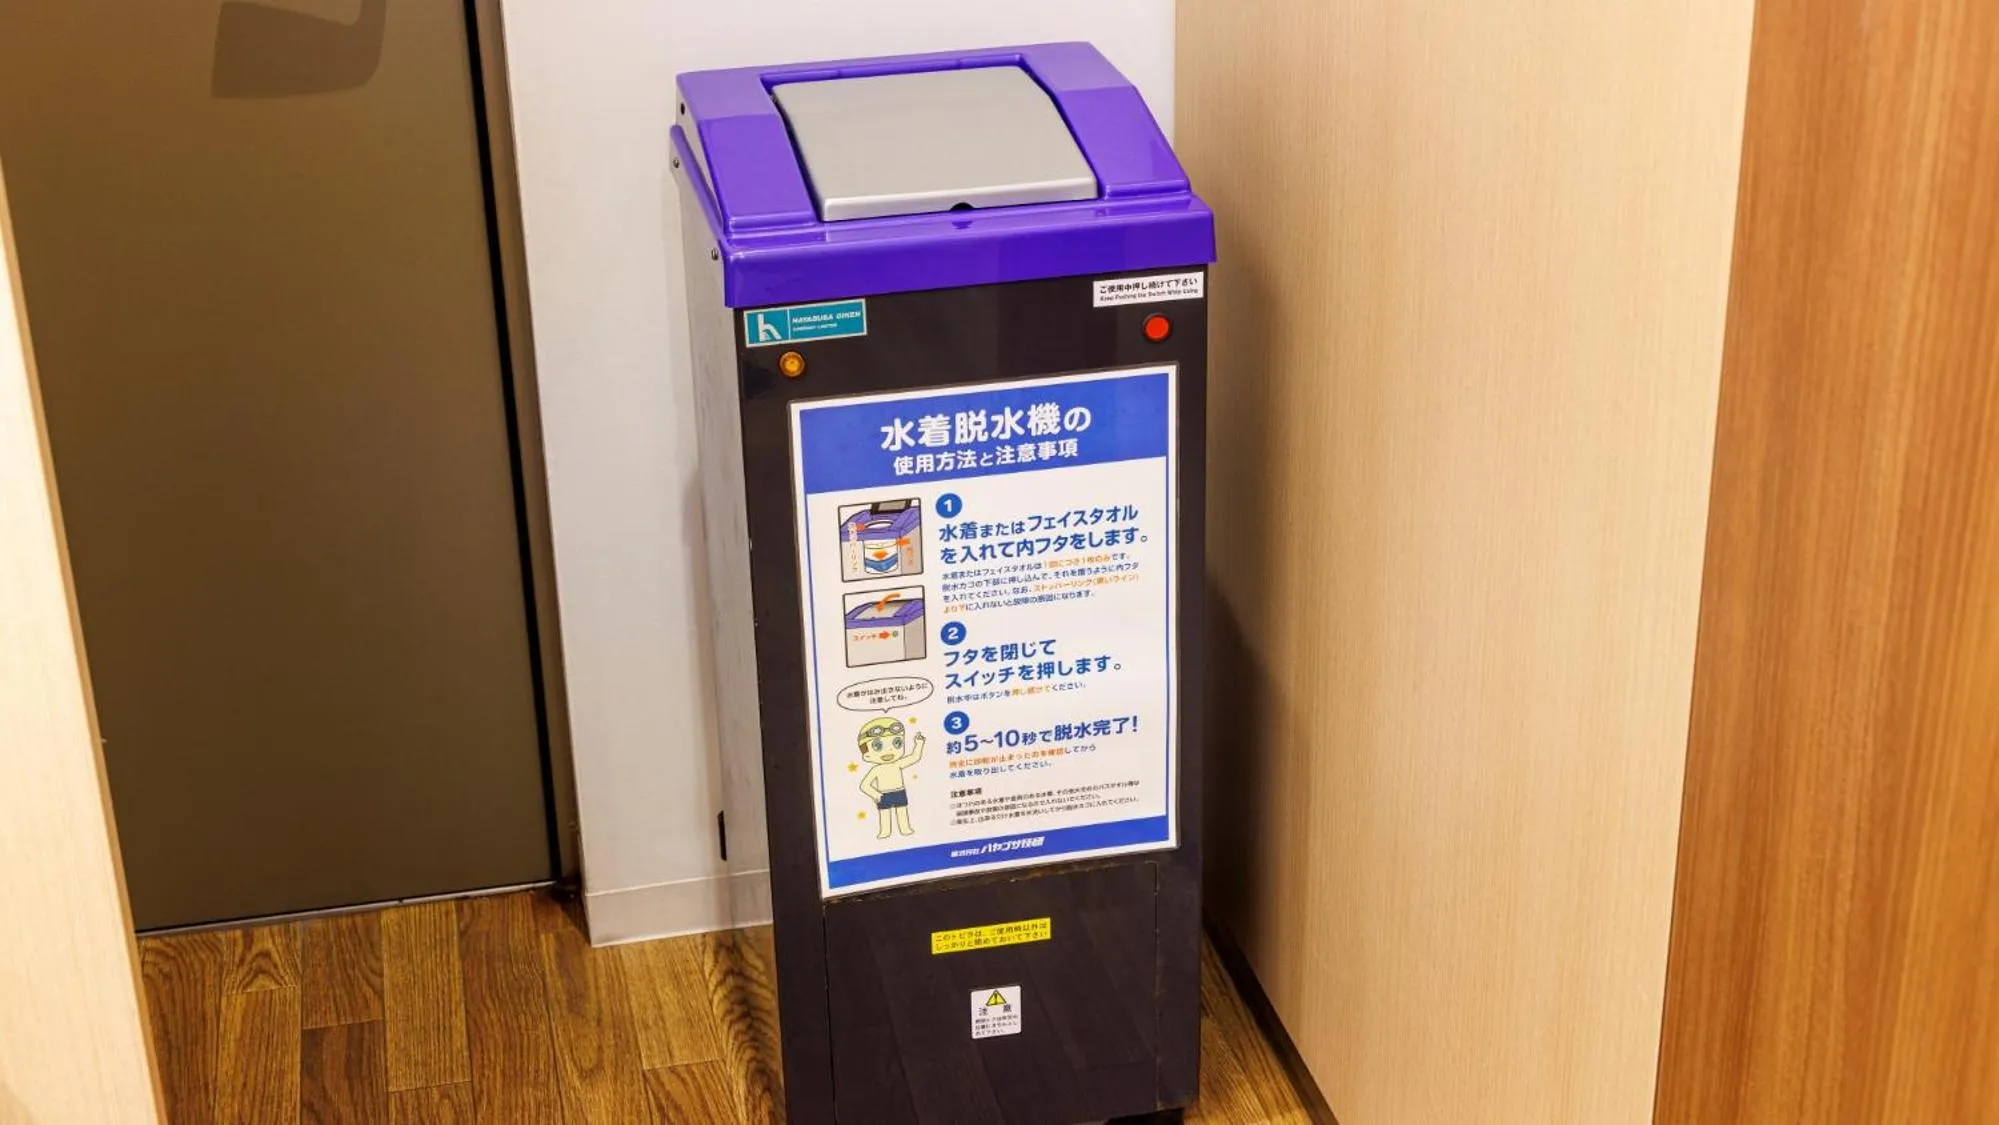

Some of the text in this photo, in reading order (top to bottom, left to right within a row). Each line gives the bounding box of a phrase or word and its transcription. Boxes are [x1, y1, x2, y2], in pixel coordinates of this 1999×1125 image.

[880, 402, 1092, 451] 水着脱水機の
[893, 438, 1079, 476] 使用方法と注意事項
[938, 504, 1139, 542] 水着またはフェイスタオル
[940, 526, 1148, 564] を入れて内フタをします。
[944, 639, 1057, 667] フタを閉じて
[944, 655, 1121, 689] スイッチを押します。
